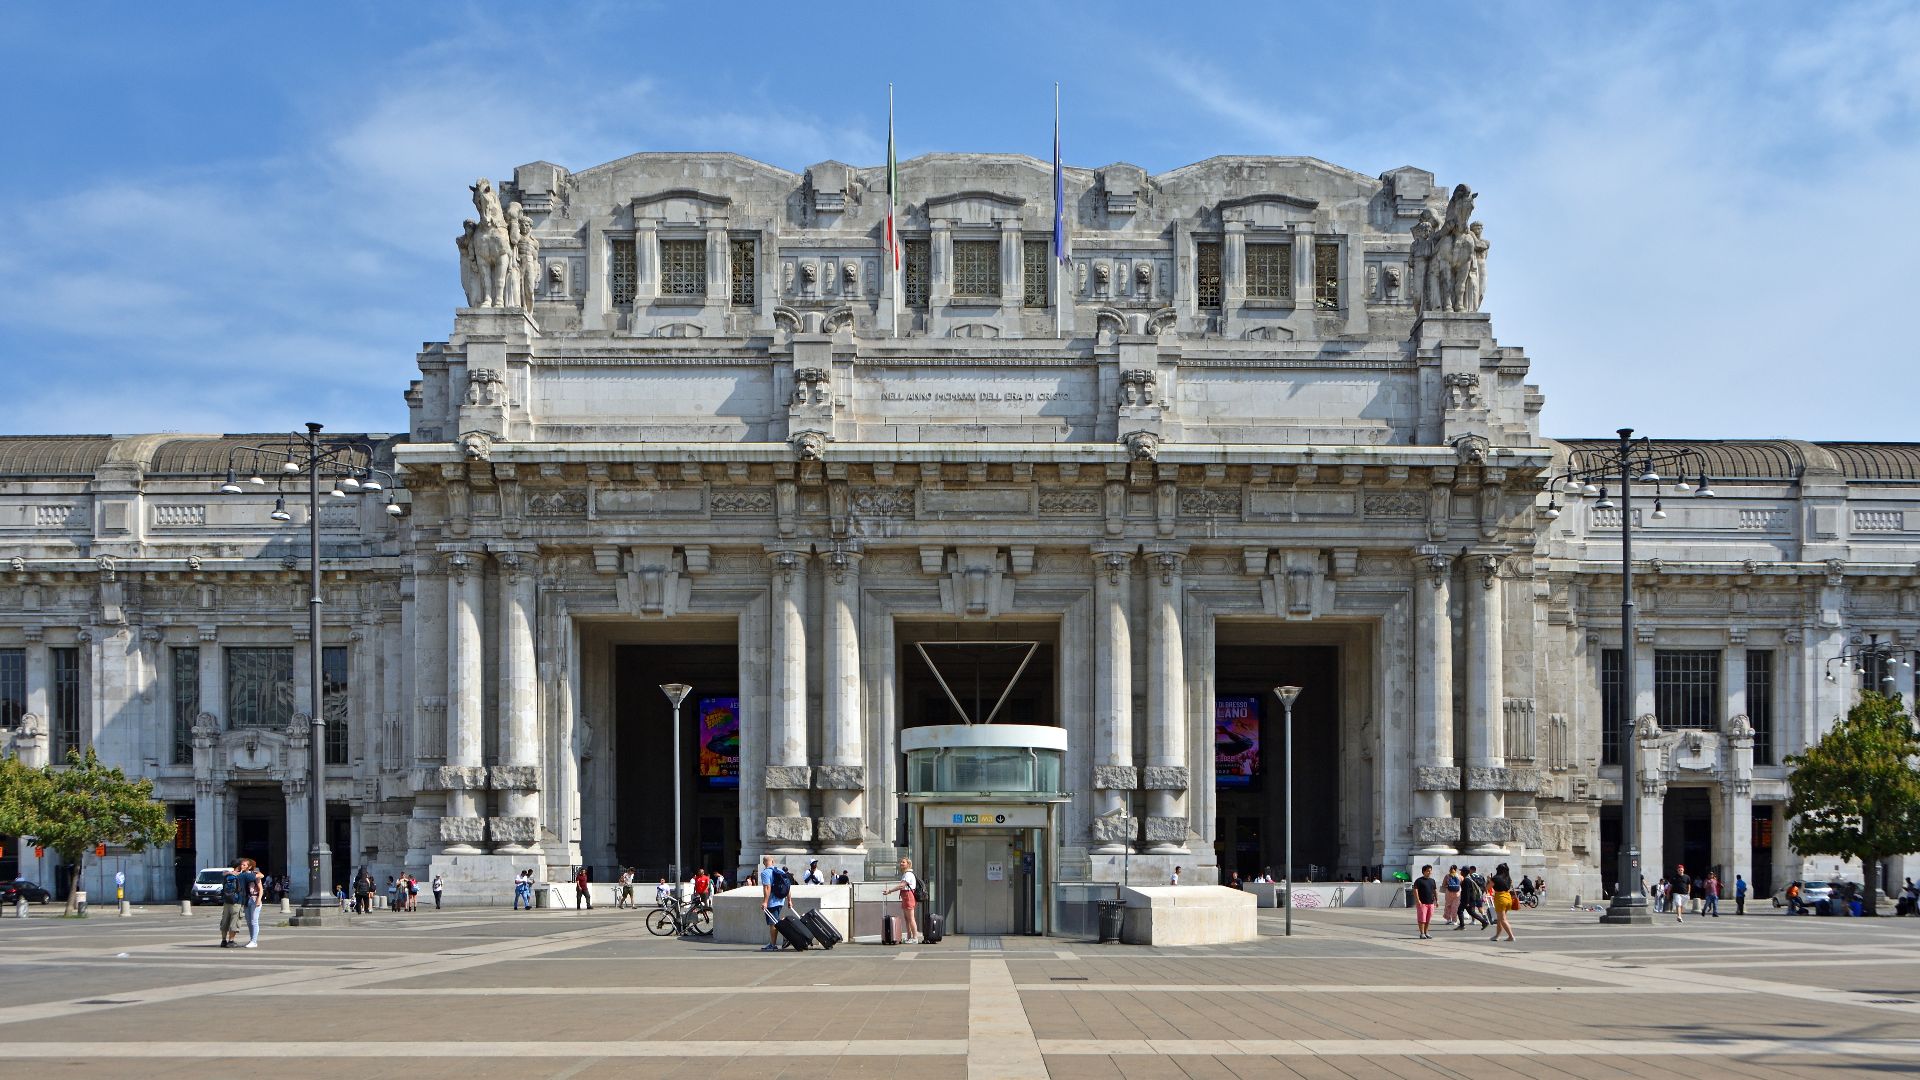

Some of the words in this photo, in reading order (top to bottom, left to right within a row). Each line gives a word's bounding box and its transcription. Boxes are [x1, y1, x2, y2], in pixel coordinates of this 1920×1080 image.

[905, 392, 932, 401] ANNO
[1004, 392, 1023, 401] ERA
[1025, 392, 1034, 401] DI
[1037, 392, 1070, 401] CRISTO
[1216, 707, 1248, 718] LANO
[965, 815, 977, 823] M2
